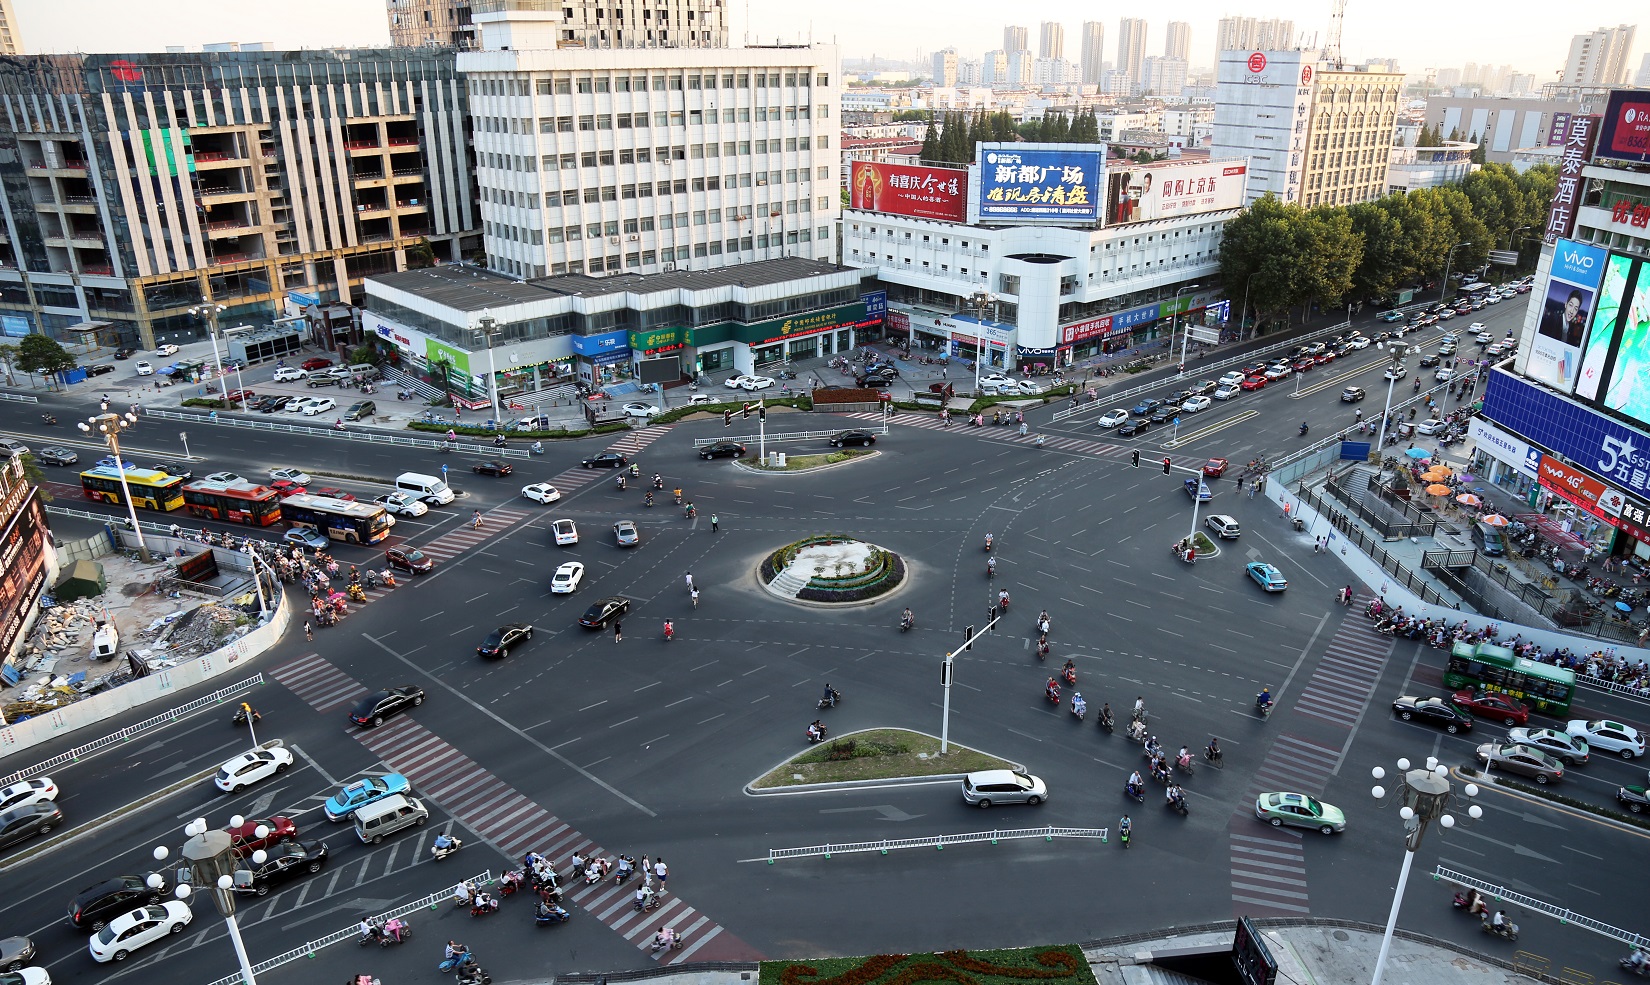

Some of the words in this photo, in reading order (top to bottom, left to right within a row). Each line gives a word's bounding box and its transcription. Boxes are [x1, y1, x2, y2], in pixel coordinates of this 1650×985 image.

[1243, 75, 1268, 84] ICBC
[994, 165, 1084, 185] 新都广场
[1547, 117, 1591, 234] 莫泰酒店
[1162, 176, 1217, 198] 网购上京东
[1563, 250, 1594, 268] vivo
[1118, 307, 1154, 326] 手机大世界
[1018, 346, 1041, 354] vivo
[1598, 434, 1618, 472] 5
